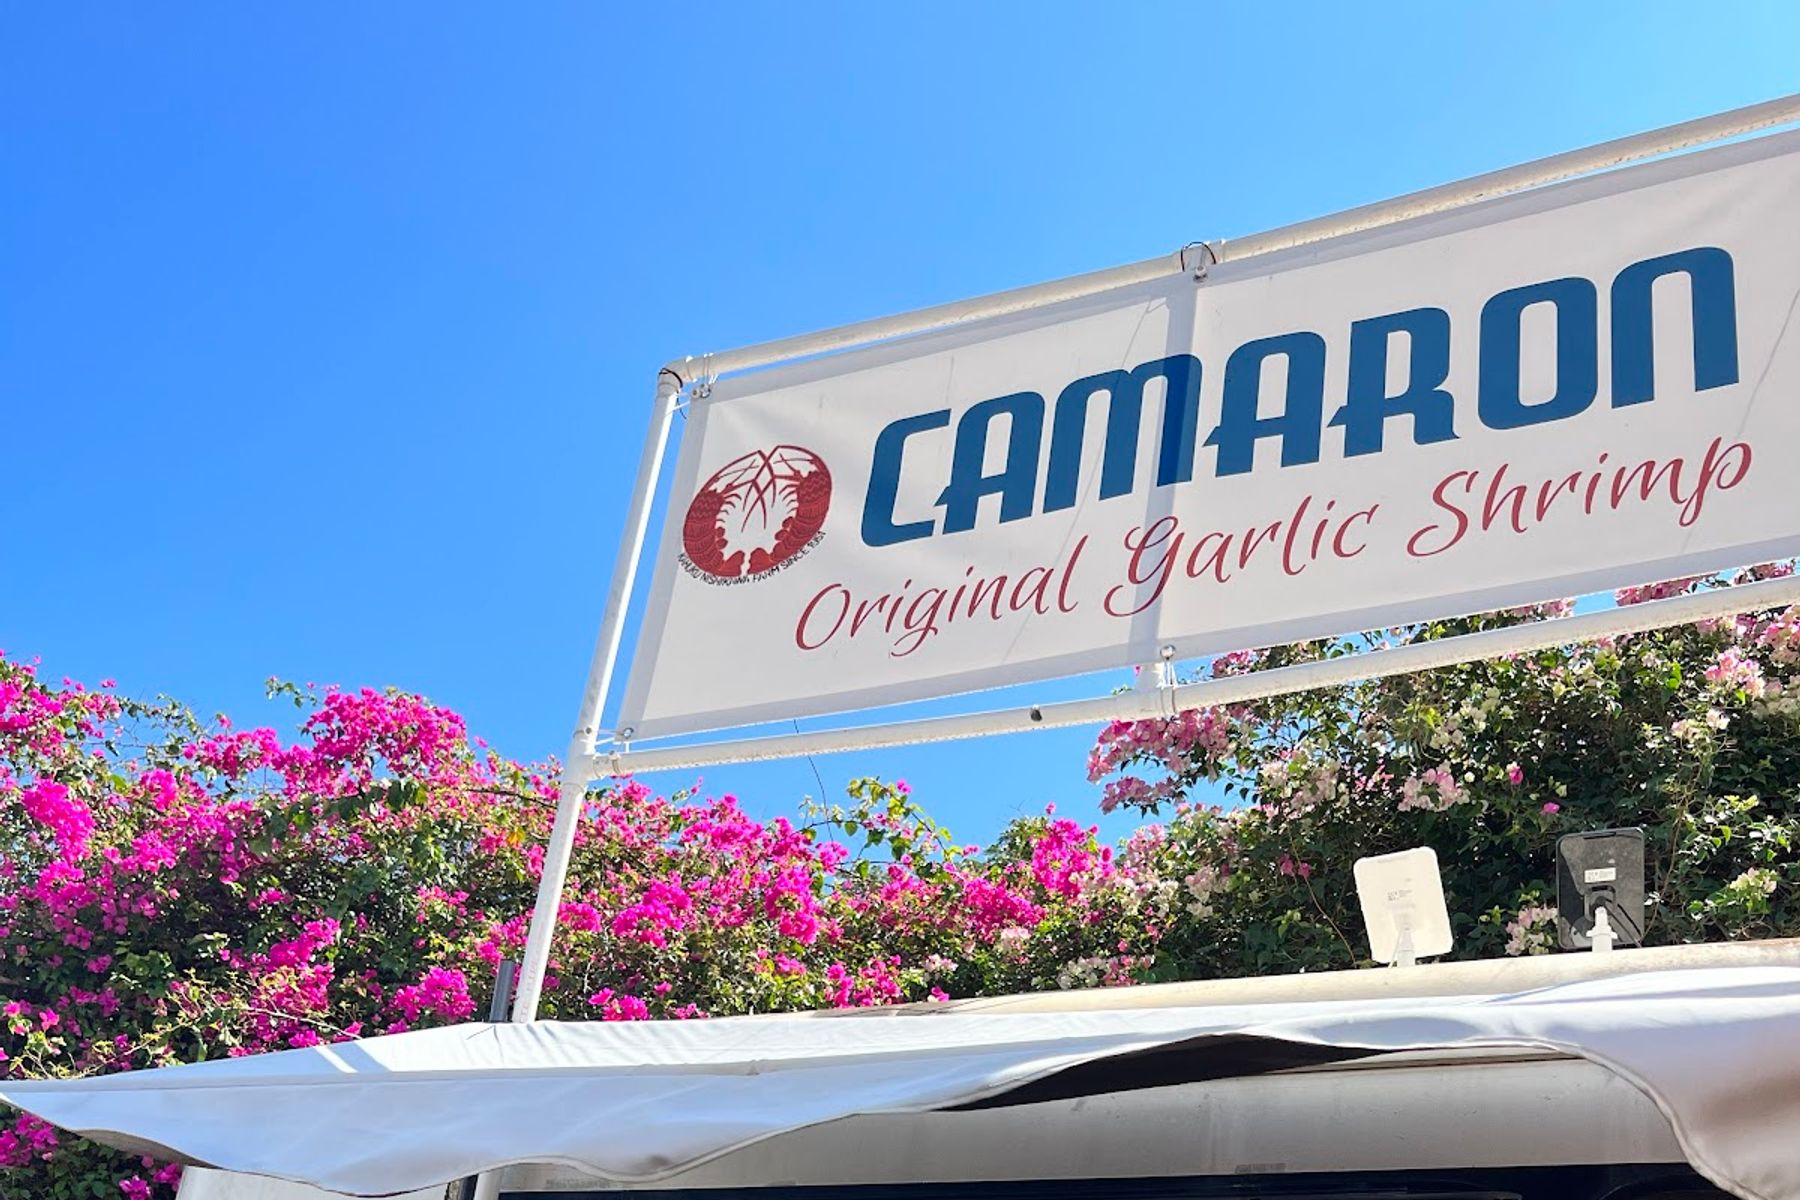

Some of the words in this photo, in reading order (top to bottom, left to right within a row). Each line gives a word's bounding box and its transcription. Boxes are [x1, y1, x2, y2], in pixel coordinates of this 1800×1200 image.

[861, 246, 1739, 547] CAMARON
[780, 548, 810, 569] SINCE
[795, 534, 1089, 657] Original
[1103, 496, 1380, 617] Garlic
[1407, 436, 1752, 557] Shrimp
